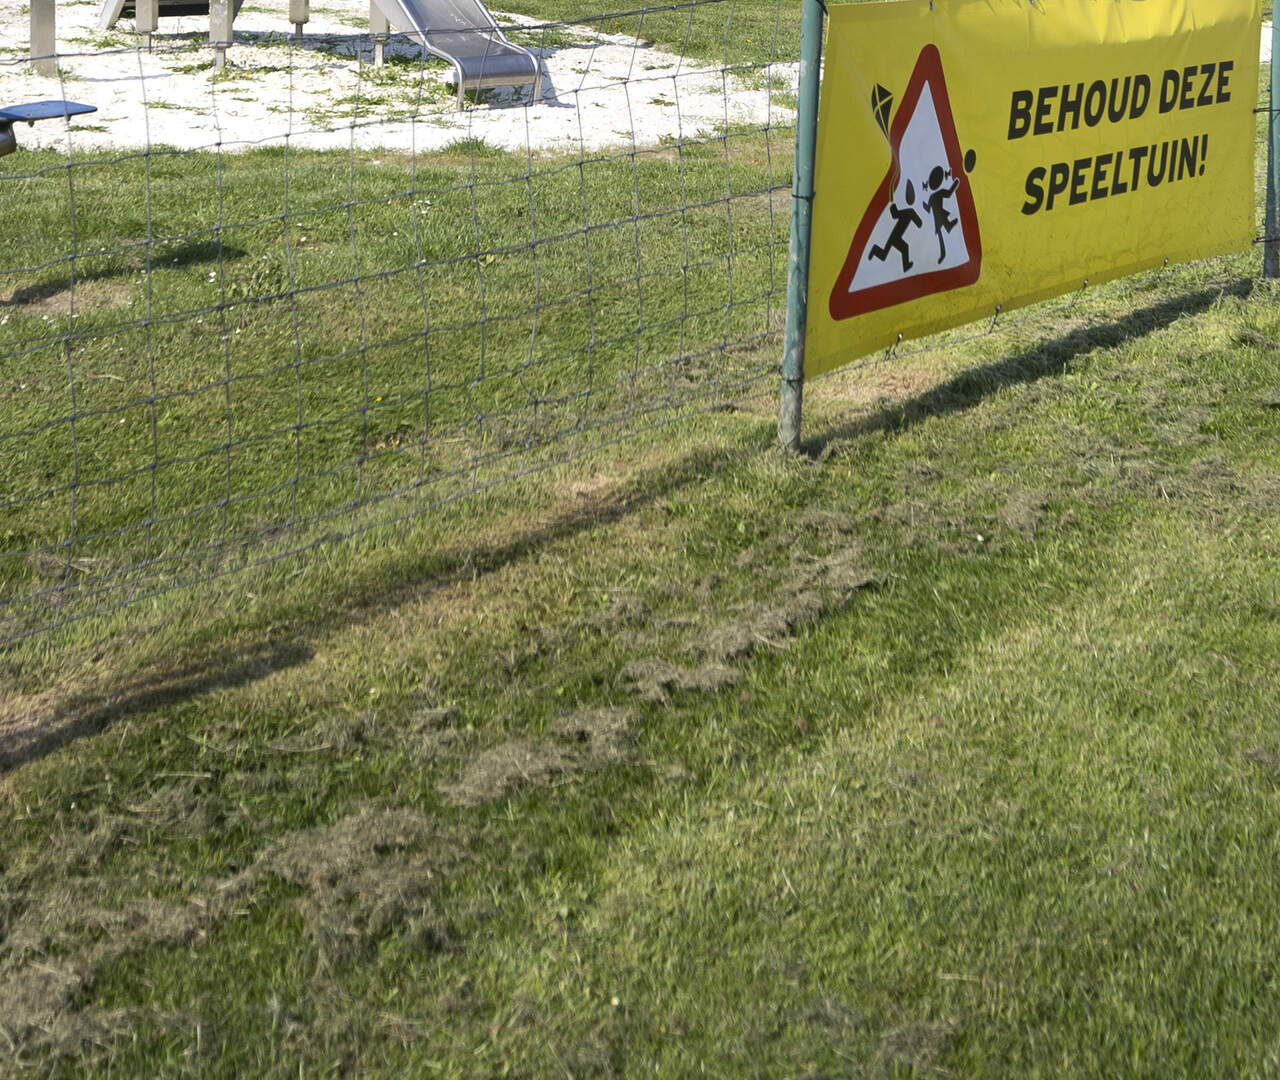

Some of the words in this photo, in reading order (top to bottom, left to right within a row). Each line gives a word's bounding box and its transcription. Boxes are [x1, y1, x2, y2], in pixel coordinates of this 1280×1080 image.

[1007, 73, 1152, 141] BEHOUD
[1158, 59, 1235, 115] DEZE
[1020, 133, 1209, 216] SPEELTUIN!
